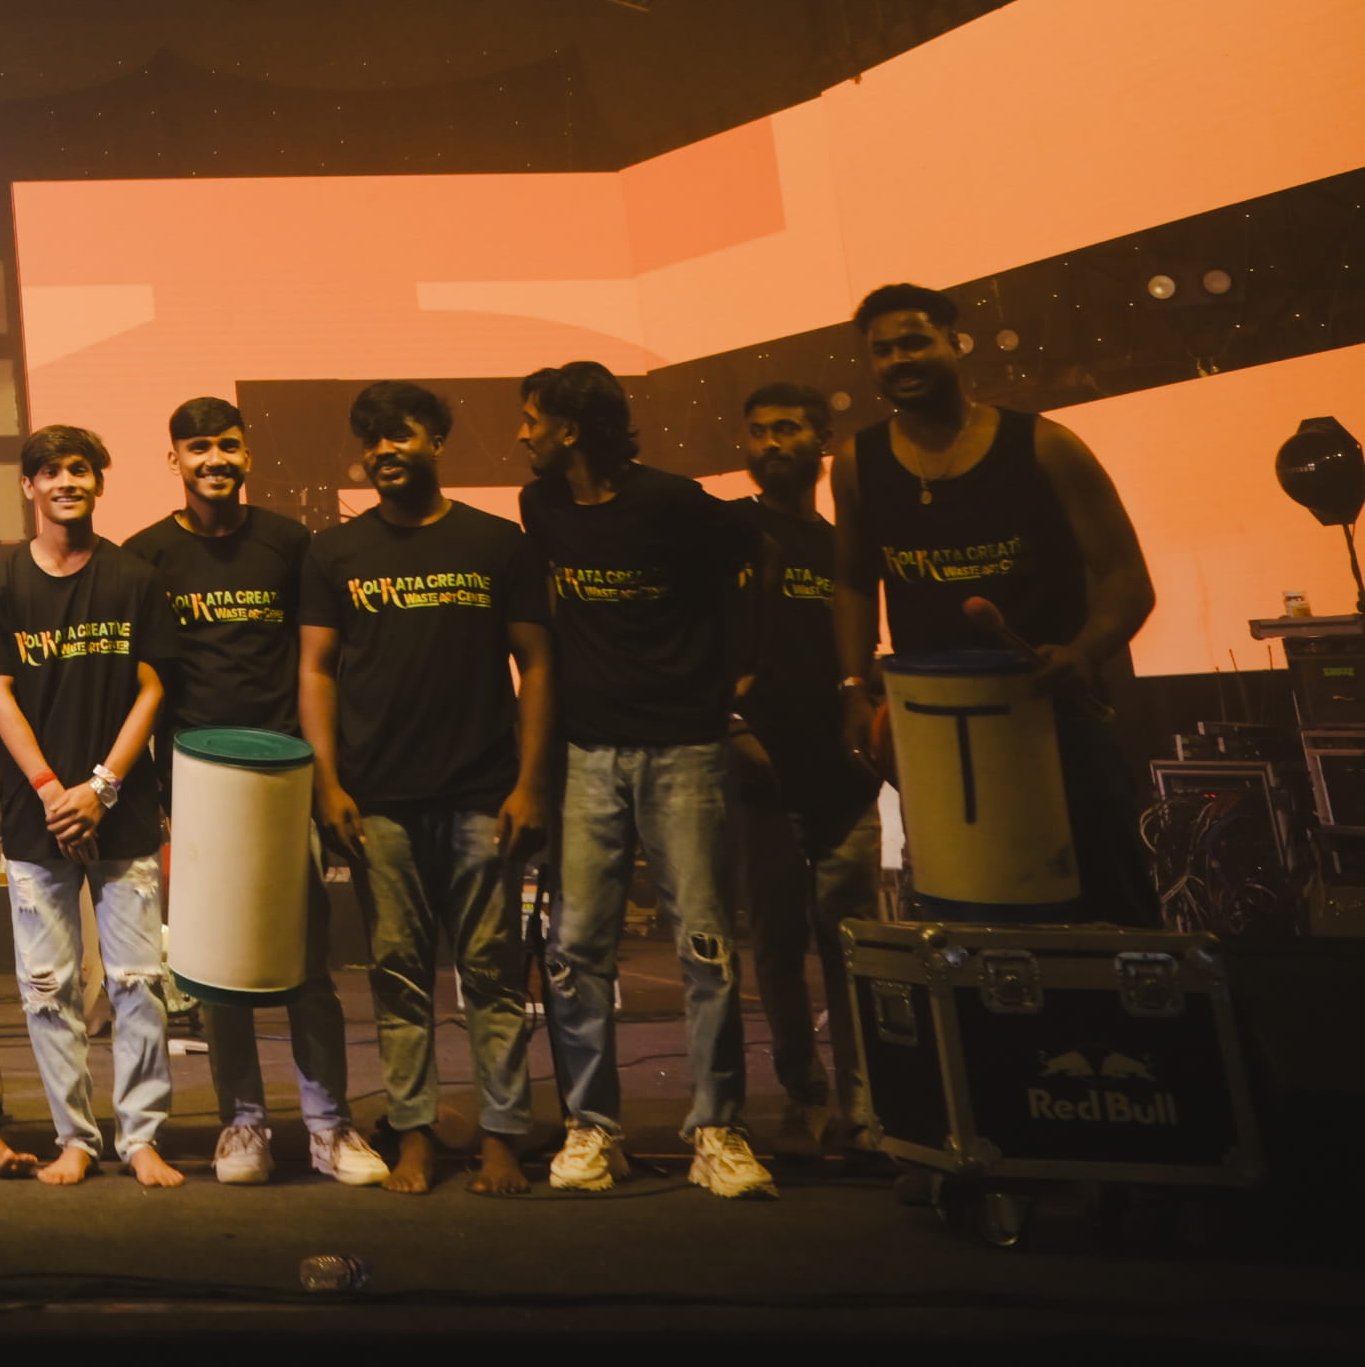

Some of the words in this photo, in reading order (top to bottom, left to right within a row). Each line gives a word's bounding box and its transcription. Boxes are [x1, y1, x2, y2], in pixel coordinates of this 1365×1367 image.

[347, 577, 425, 613] KOLKATA
[427, 572, 492, 590] CREATIVE
[403, 592, 438, 605] WASTE
[1027, 1088, 1102, 1121] Red
[1104, 1090, 1178, 1126] Bull
